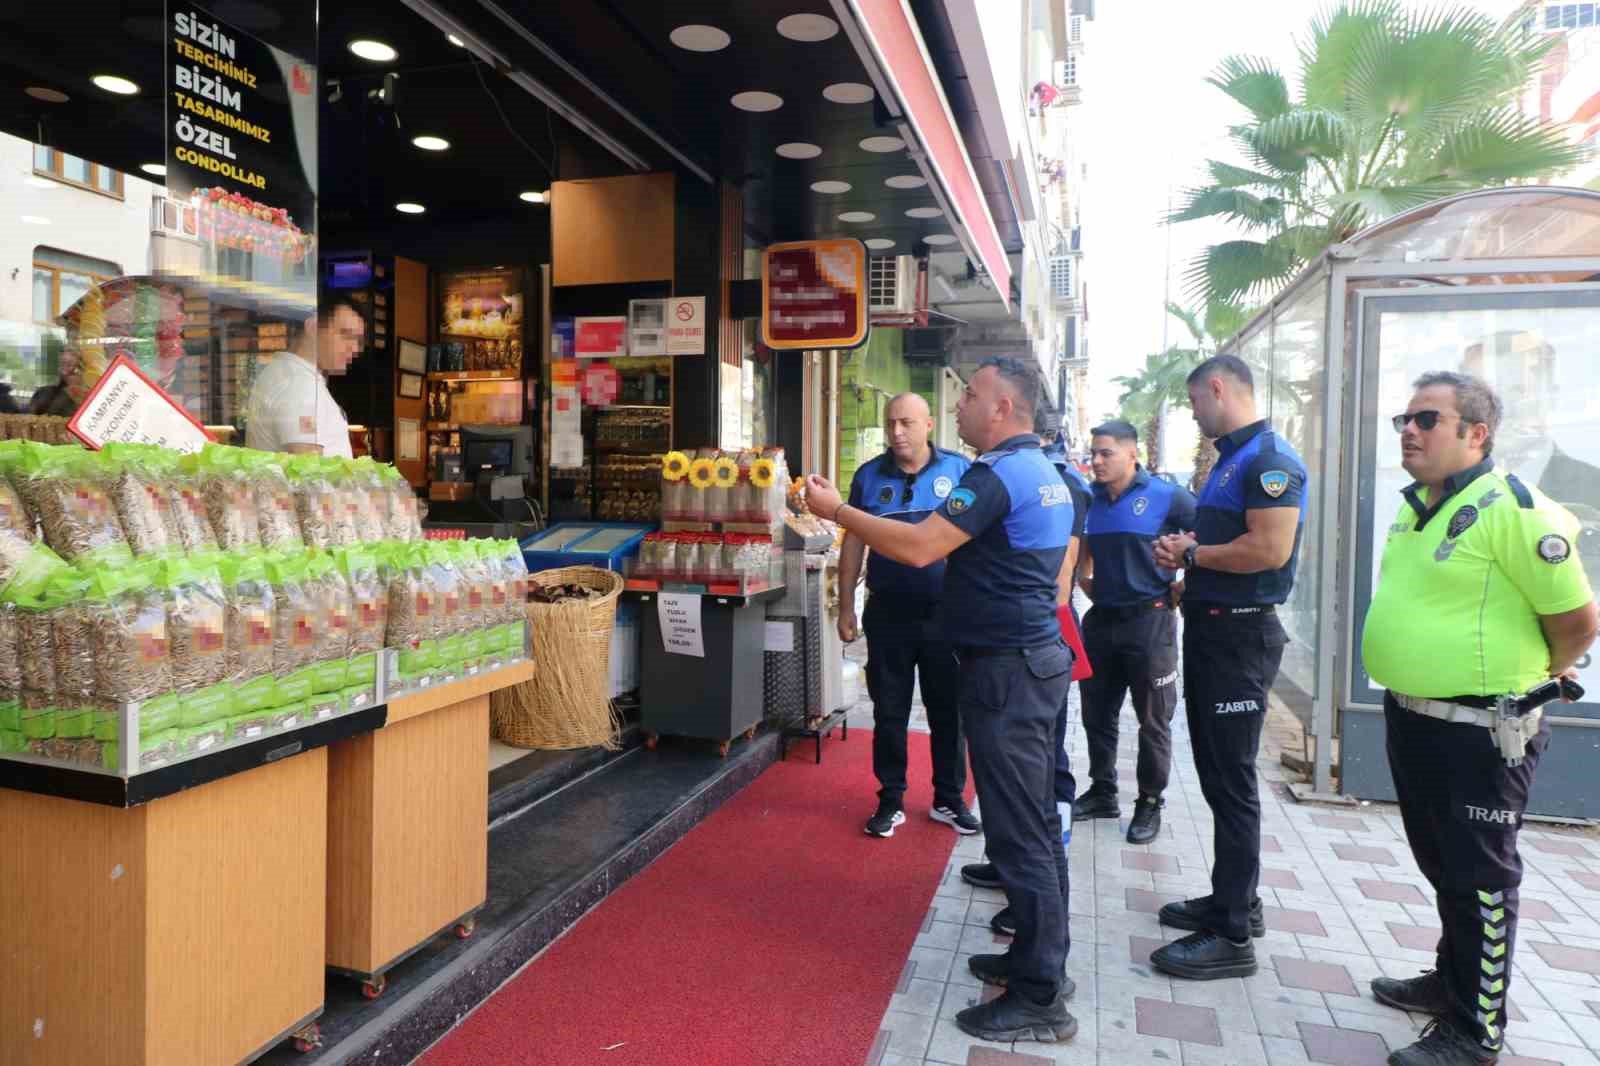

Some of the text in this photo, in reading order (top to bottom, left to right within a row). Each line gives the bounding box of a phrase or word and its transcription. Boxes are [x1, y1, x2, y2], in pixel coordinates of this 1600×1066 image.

[174, 11, 236, 60] SİZİN
[174, 38, 257, 89] TERCİHİNİZ
[175, 65, 241, 112] BİZİM
[175, 92, 271, 144] TASARIMIMIZ
[175, 114, 237, 160] ÖZEL
[175, 145, 266, 190] GONDOLLAR
[86, 379, 129, 432] KAMPANYA
[1215, 700, 1260, 714] ZABITA
